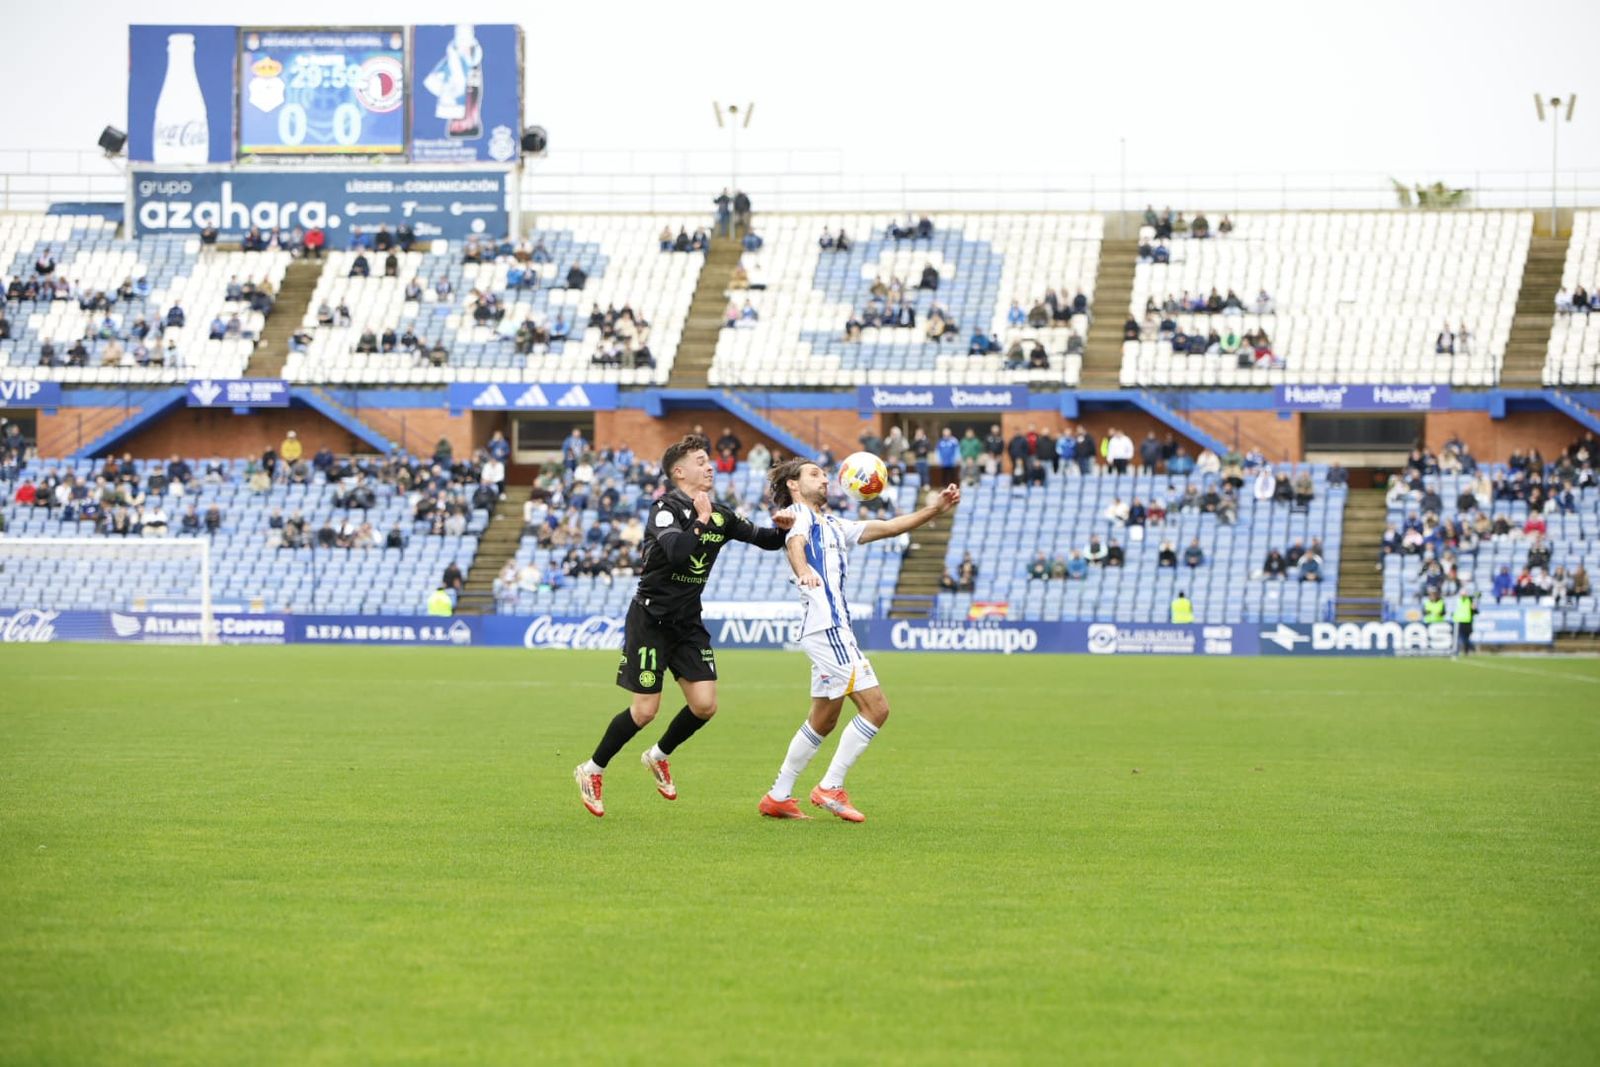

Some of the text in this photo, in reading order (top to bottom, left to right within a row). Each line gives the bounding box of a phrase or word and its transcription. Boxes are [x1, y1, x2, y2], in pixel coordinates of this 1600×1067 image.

[278, 103, 307, 145] 0
[333, 103, 362, 145] 0
[139, 180, 192, 197] grupo
[0, 381, 40, 400] VIP
[145, 617, 221, 634] ATLANTC
[891, 620, 1038, 654] Cruzcampo
[1312, 622, 1453, 650] DAMAS
[638, 647, 657, 670] 11
